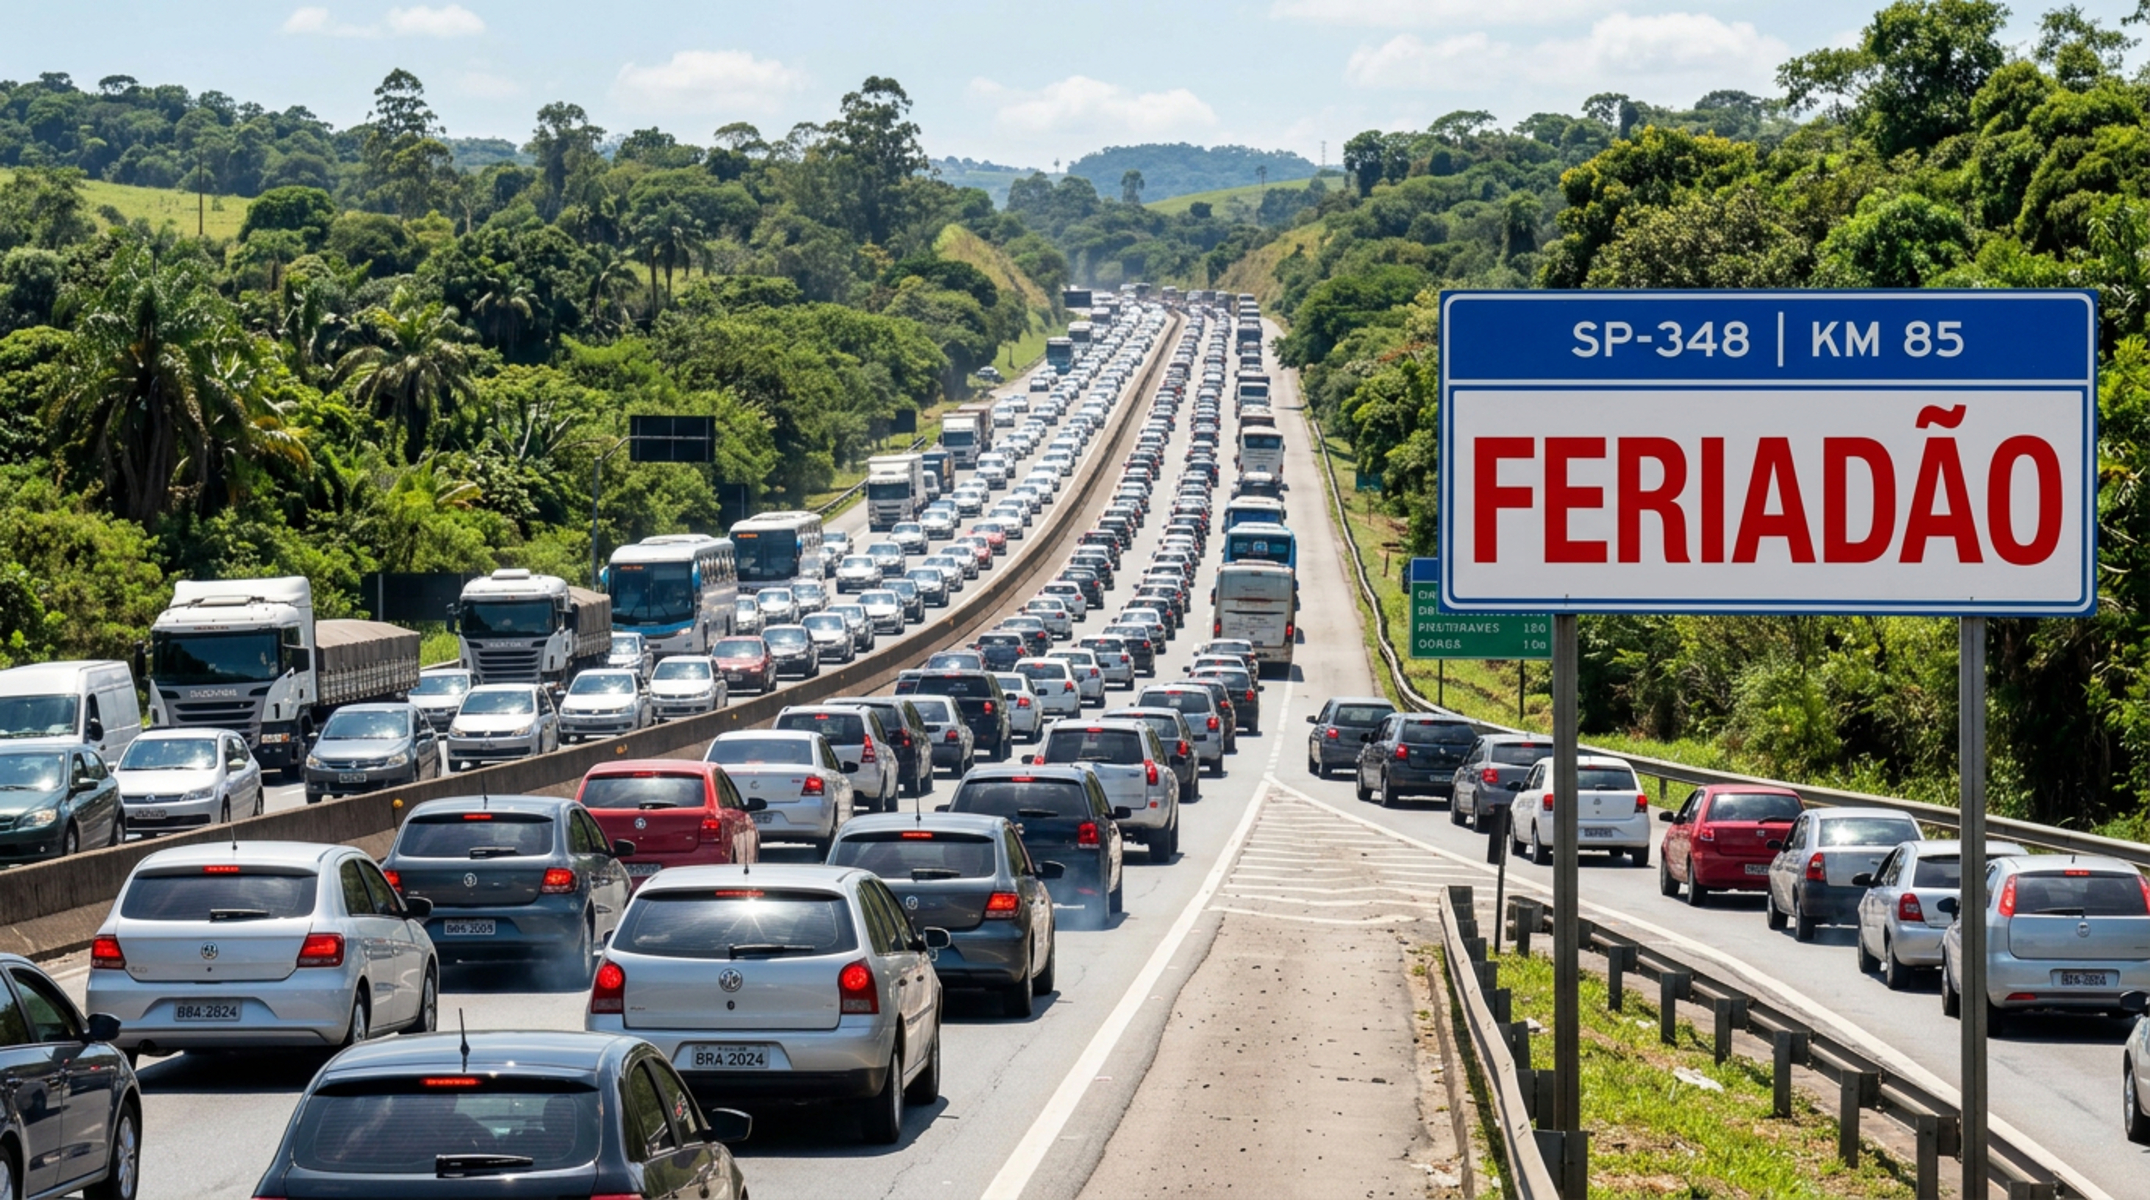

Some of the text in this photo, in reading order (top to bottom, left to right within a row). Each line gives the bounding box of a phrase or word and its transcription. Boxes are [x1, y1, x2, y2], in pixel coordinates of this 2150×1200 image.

[1571, 320, 1964, 358] SP-348 KM 85
[1473, 404, 2063, 566] FERIADÃO
